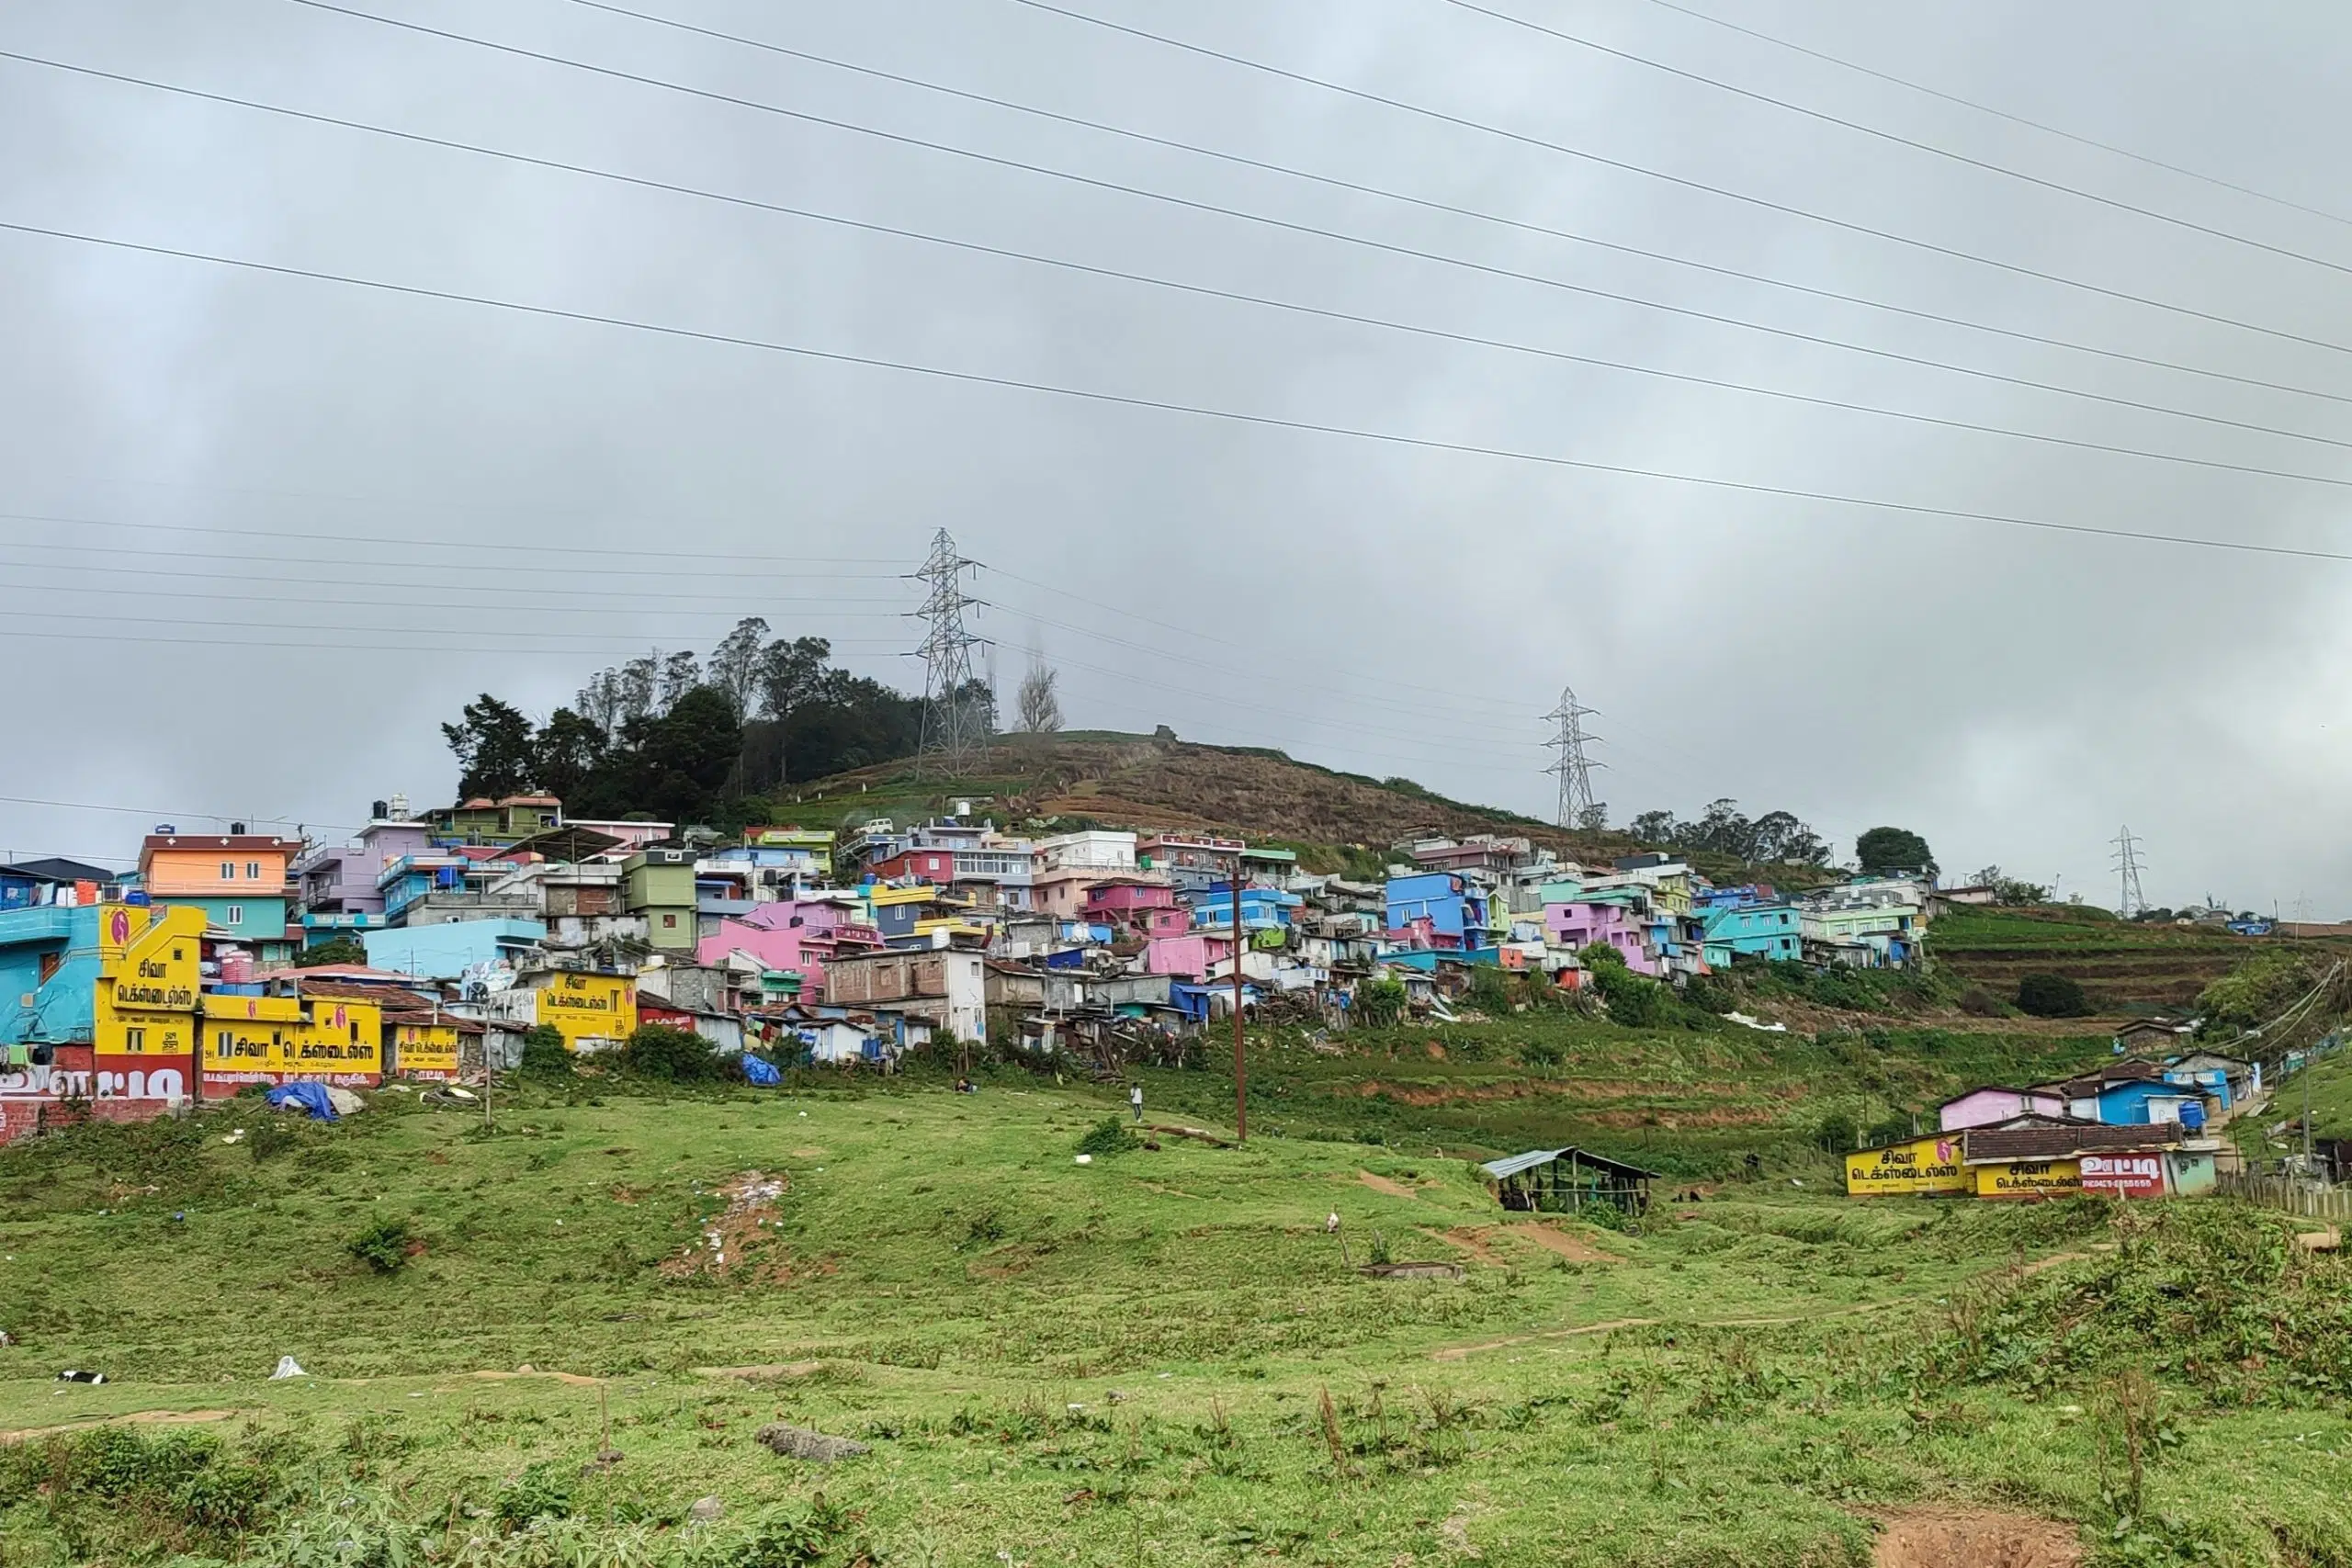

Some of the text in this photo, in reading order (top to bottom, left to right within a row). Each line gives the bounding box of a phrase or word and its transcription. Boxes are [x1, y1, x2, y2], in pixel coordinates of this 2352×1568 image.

[139, 958, 167, 978] சிவா
[564, 974, 587, 990] சிவா
[118, 983, 192, 1005] டெக்ஸ்டைல்ஸ்
[234, 1037, 269, 1057] சிவா
[1881, 1149, 1918, 1165] சிவா
[1851, 1163, 1958, 1180] டெக்ஸ்டைல்ஸ்
[2080, 1156, 2160, 1179] ஊட்டி
